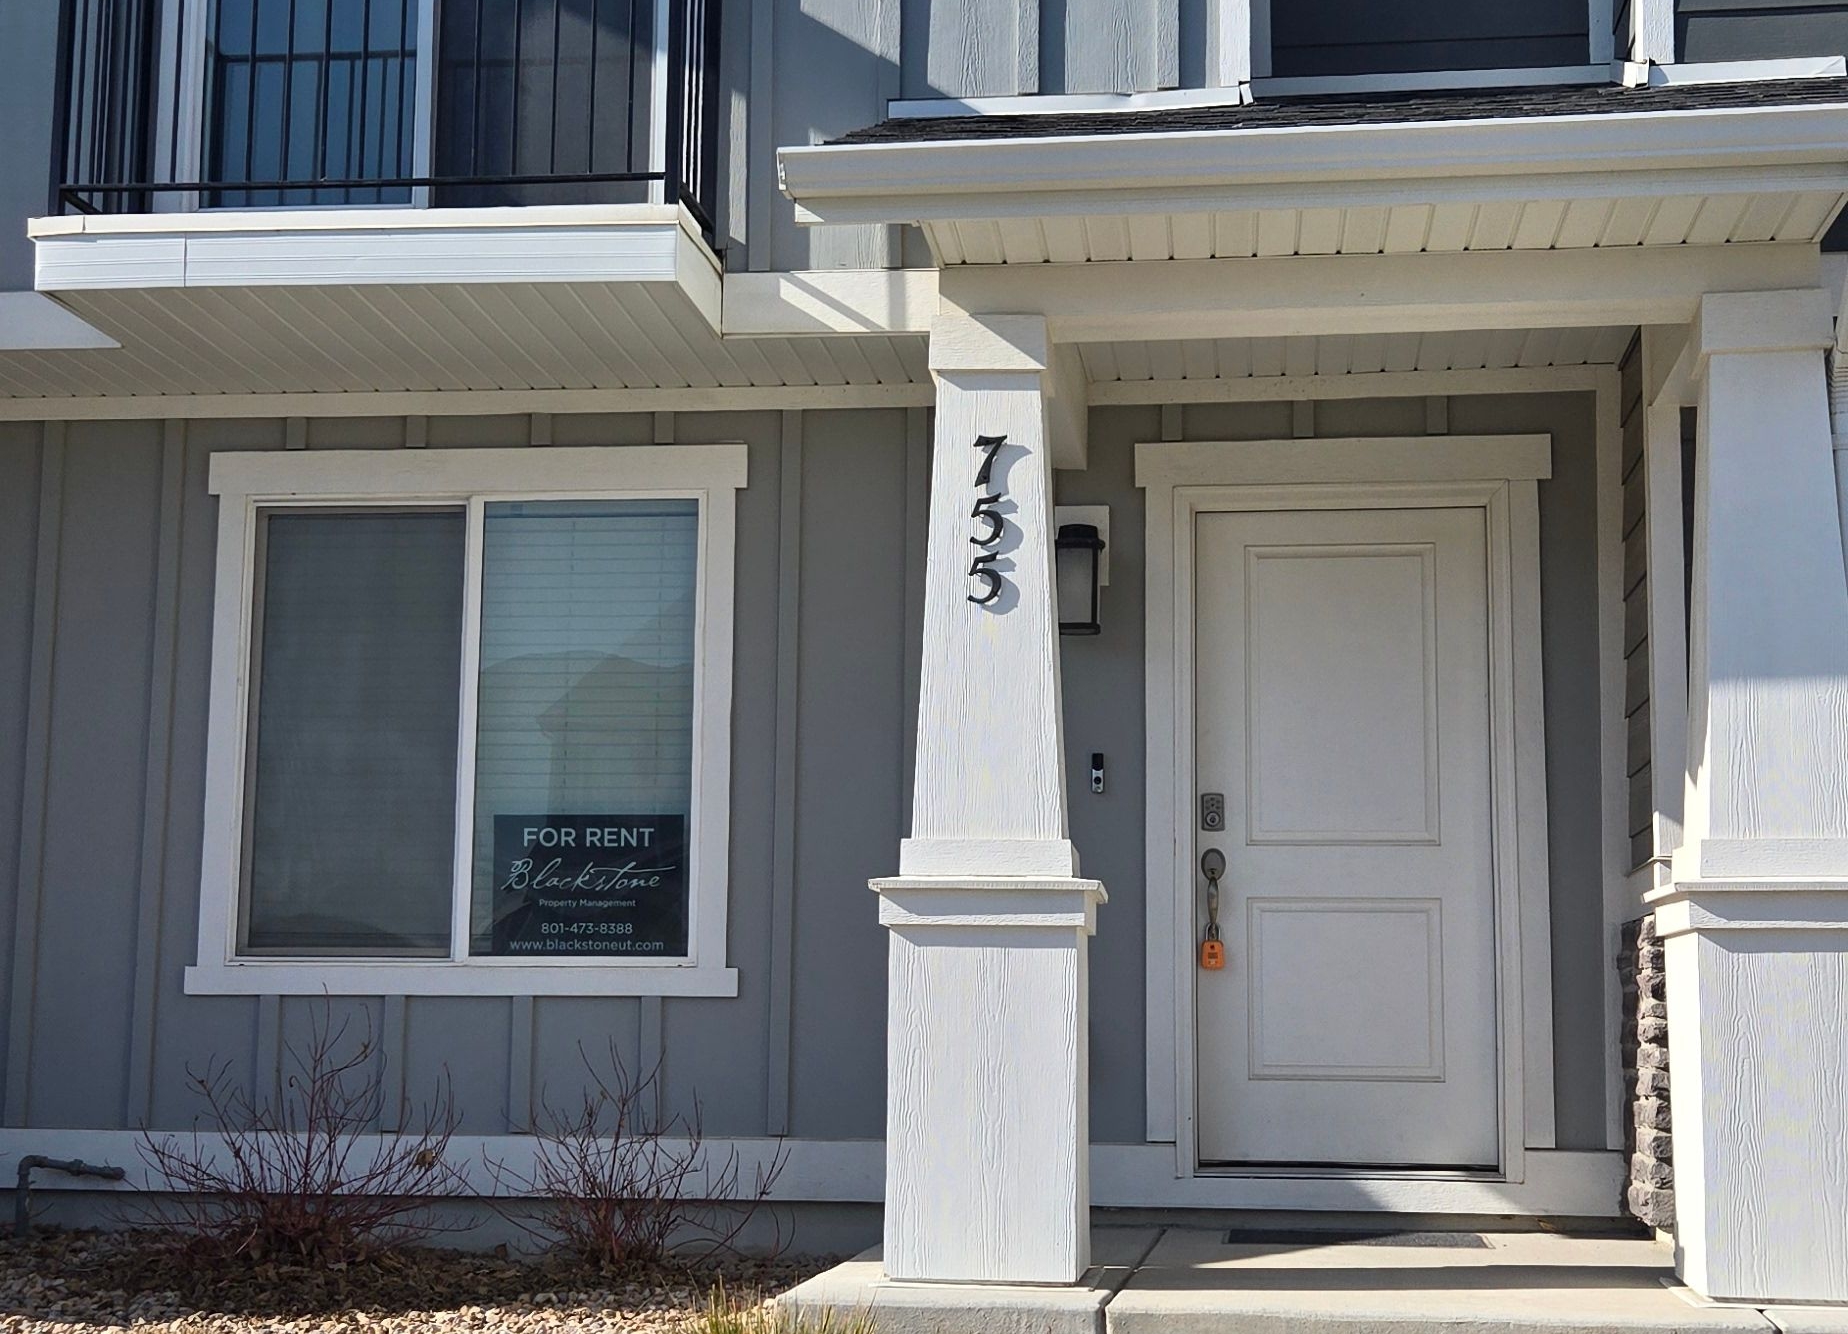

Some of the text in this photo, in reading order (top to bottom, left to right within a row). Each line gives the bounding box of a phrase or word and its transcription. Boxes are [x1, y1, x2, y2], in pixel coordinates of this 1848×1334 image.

[967, 434, 1008, 605] 755
[523, 827, 655, 847] FOR RENT
[501, 857, 677, 892] Blackstone
[539, 898, 636, 909] Property Management
[541, 922, 633, 935] 801-473-8388
[510, 938, 664, 951] www.blackstoneut.com
